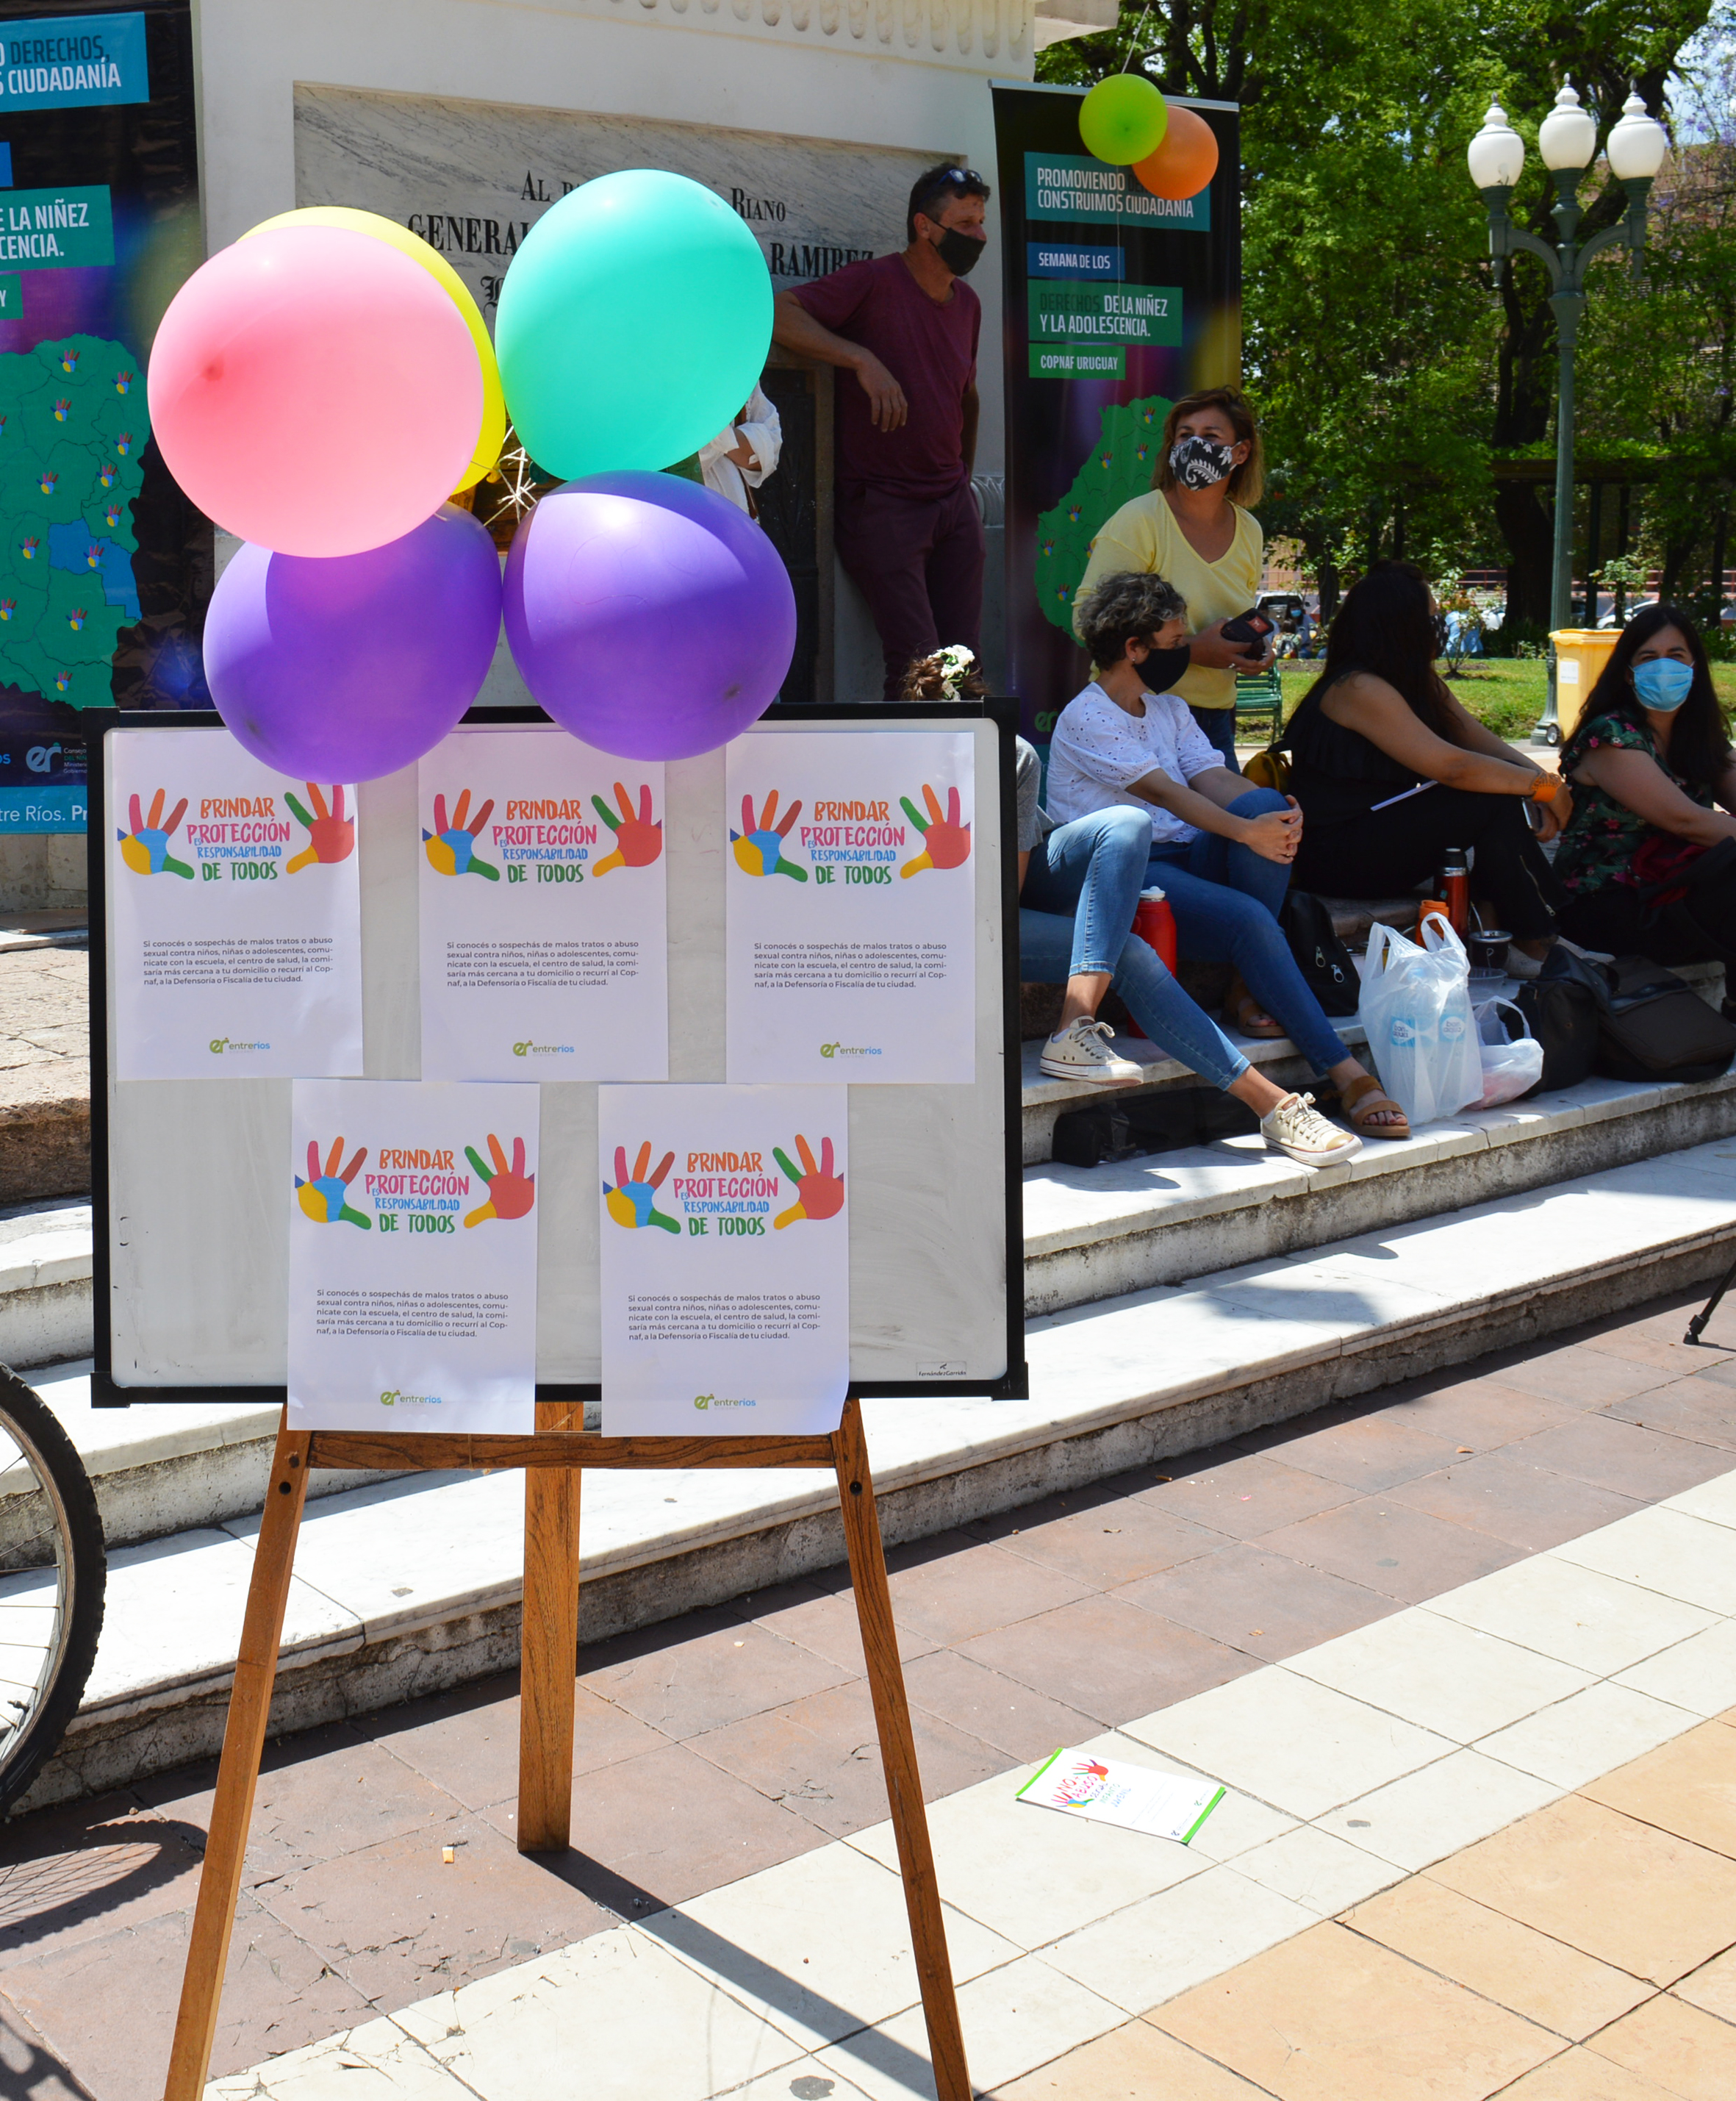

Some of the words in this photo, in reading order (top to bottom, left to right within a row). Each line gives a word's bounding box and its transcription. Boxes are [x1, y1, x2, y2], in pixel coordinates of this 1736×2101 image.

[10, 35, 110, 65] DERECHOS,
[8, 57, 121, 94] CIUDADANÍA
[1038, 168, 1125, 190] PROMOVIENDO
[1039, 190, 1123, 212] CONSTRUIMOS
[10, 207, 32, 230] LA
[35, 198, 89, 229] NIÑEZ
[1039, 252, 1077, 267] SEMANA
[1080, 255, 1090, 268] DE
[1093, 256, 1110, 269] LOS
[1041, 293, 1100, 312] DERECHOS
[1104, 296, 1119, 313] DE
[1122, 296, 1133, 314] LA
[1136, 294, 1167, 316] NIÑEZ
[1040, 315, 1047, 332] Y
[1051, 315, 1066, 332] LA
[1069, 315, 1150, 337] ADOLESCENCIA.
[1041, 355, 1075, 369] COPNAF
[1077, 357, 1118, 370] URUGUAY
[26, 806, 65, 821] Ríos.
[201, 798, 275, 818] BRINDAR
[506, 799, 581, 820] BRINDAR
[814, 801, 890, 821] BRINDAR
[187, 818, 290, 843] PROTECCIÓN
[492, 821, 596, 845] PROTECCIÓN
[800, 822, 905, 846] PROTECCIÓN
[198, 846, 281, 859] RESPONSABILIDAD
[503, 848, 588, 860] RESPONSABILIDAD
[811, 850, 896, 861] RESPONSABILIDAD
[202, 862, 222, 881] DE
[231, 862, 278, 881] TODOS
[507, 865, 527, 883] DE
[538, 865, 584, 882] TODOS
[815, 866, 835, 884] DE
[844, 866, 892, 884] TODOS
[195, 939, 235, 948] sospechás
[252, 948, 306, 957] adolescentes,
[499, 942, 540, 950] sospechás
[557, 951, 611, 959] adolescentes,
[809, 952, 833, 960] niños,
[379, 1149, 454, 1170] BRINDAR
[687, 1152, 763, 1173] BRINDAR
[365, 1172, 469, 1195] PROTECCIÓN
[673, 1173, 778, 1198] PROTECCIÓN
[375, 1198, 459, 1211] RESPONSABILIDAD
[684, 1201, 770, 1213] RESPONSABILIDAD
[379, 1214, 399, 1232] DE
[408, 1214, 455, 1234] TODOS
[689, 1217, 709, 1236] DE
[717, 1217, 765, 1235] TODOS
[369, 1291, 410, 1300] sospechás
[427, 1301, 481, 1309] adolescentes,
[739, 1304, 792, 1313] adolescentes,
[1056, 1779, 1077, 1792] NO
